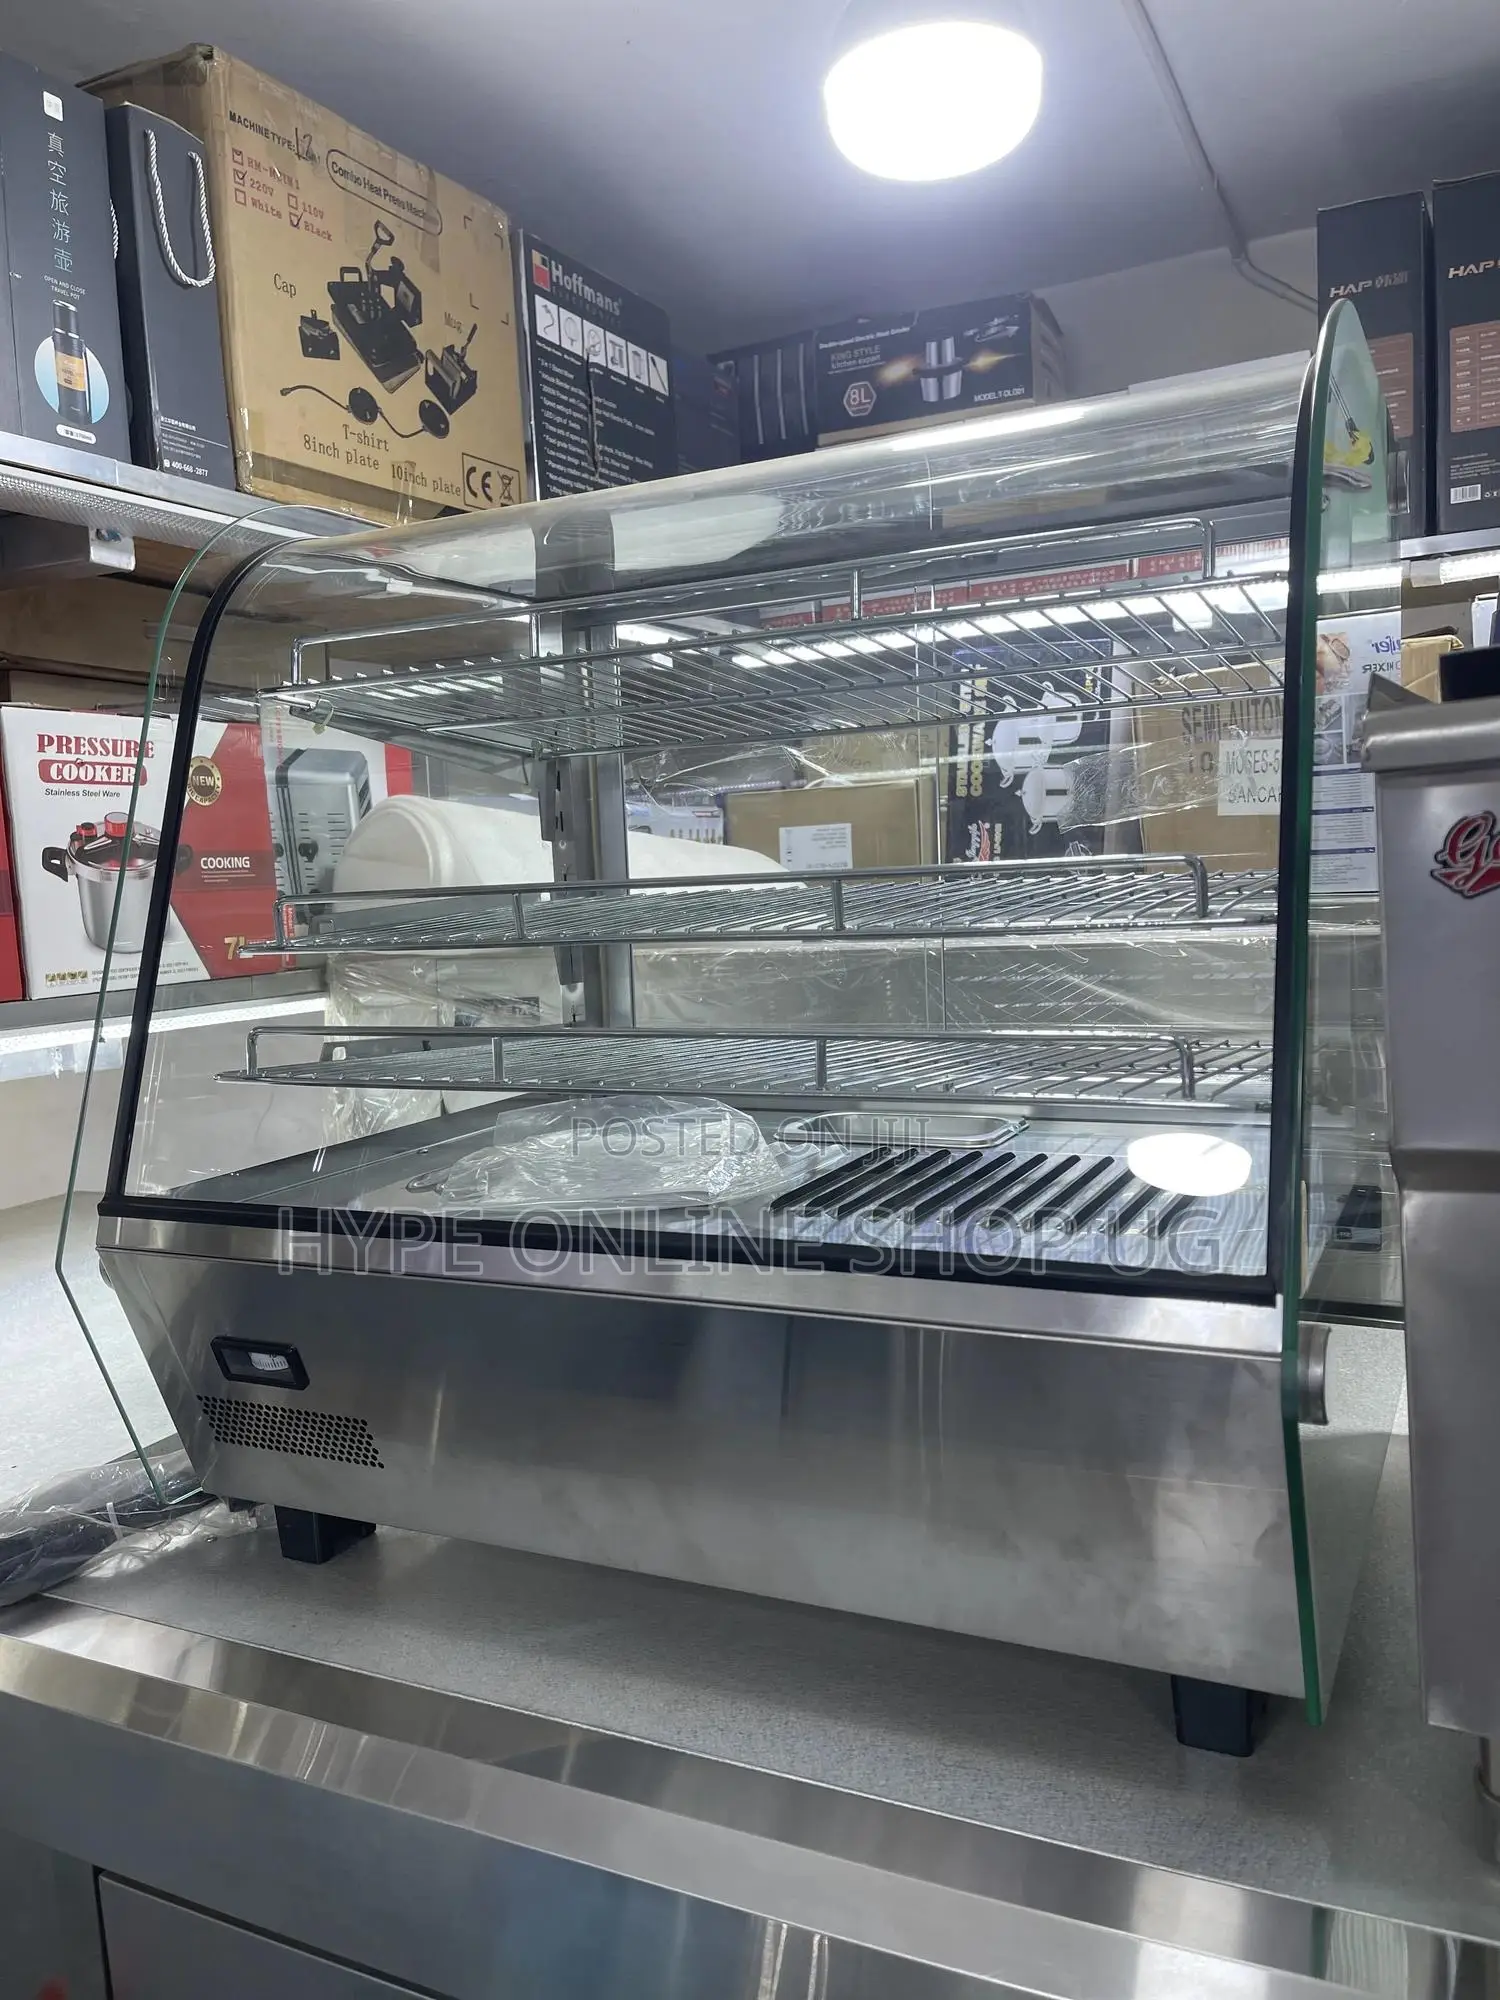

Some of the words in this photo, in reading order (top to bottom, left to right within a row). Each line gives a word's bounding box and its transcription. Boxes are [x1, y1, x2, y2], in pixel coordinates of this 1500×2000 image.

[229, 110, 270, 139] MACHINE
[249, 178, 274, 197] 220V
[302, 202, 324, 220] 110V
[363, 178, 383, 198] Heat
[47, 131, 73, 273] 真空旅游壶
[250, 197, 282, 219] White
[303, 221, 333, 241] Black
[1447, 260, 1495, 279] HAP
[43, 275, 58, 285] OPEN
[58, 280, 70, 290] AND
[70, 284, 86, 295] CLOSE
[51, 285, 68, 297] TRAVEL
[68, 291, 81, 301] POT
[273, 272, 297, 299] Cap
[551, 260, 621, 316] Hoffmans
[1328, 280, 1373, 298] HAP
[849, 387, 871, 406] 8L
[342, 424, 389, 452] T-shirt
[303, 434, 340, 459] 8inch
[346, 448, 380, 470] plate
[391, 463, 428, 488] 10inch
[432, 476, 461, 498] plate
[465, 466, 493, 503] CE
[36, 733, 155, 759] PRESSURE
[49, 762, 137, 783] COOKER
[192, 775, 215, 787] NEW
[44, 788, 80, 797] Stainless
[82, 789, 101, 797] Steel
[102, 790, 121, 798] Ware
[200, 856, 250, 869] COOKING
